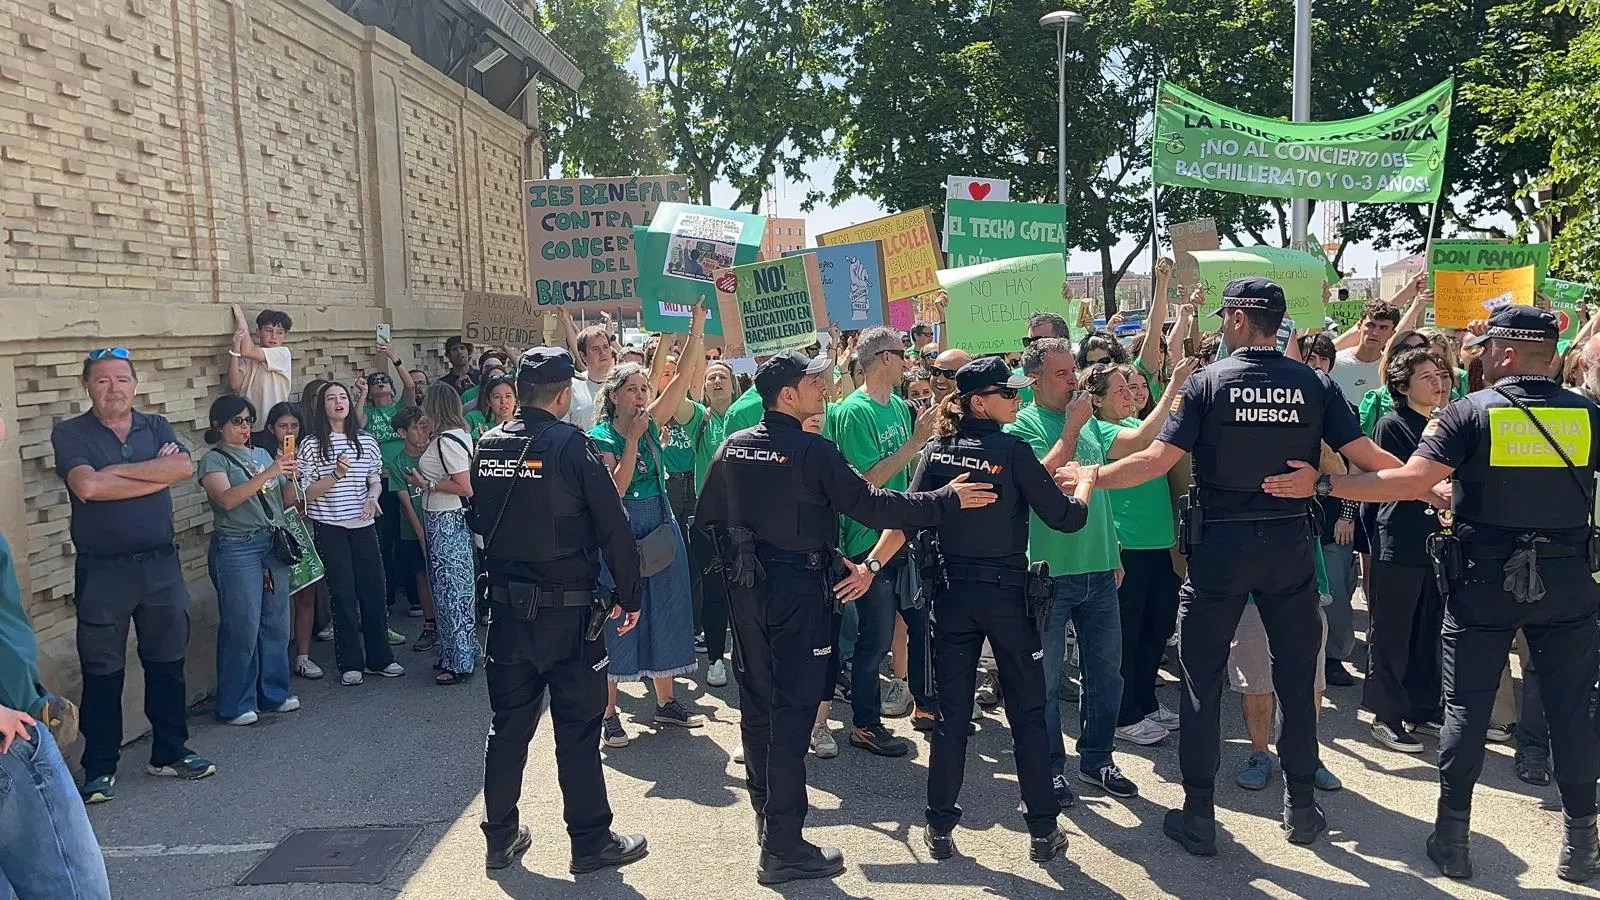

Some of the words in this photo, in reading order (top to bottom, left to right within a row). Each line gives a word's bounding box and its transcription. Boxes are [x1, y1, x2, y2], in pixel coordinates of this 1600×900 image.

[1184, 114, 1213, 129] LA
[1200, 140, 1239, 159] ¡NO
[1243, 141, 1269, 158] AL
[1274, 142, 1379, 168] CONCIERTO
[1381, 152, 1414, 168] DEL
[1175, 160, 1322, 188] BACHILLERATO
[1326, 173, 1338, 189] Y
[1376, 170, 1432, 193] AÑOS!
[579, 177, 681, 207] BINÉFAR
[541, 210, 634, 232] CONTRA
[949, 216, 966, 236] EL
[969, 217, 1016, 240] TECHO
[1020, 221, 1066, 244] GOTEA
[591, 257, 631, 274] DEL
[1433, 249, 1472, 266] DON
[752, 264, 788, 296] NO!
[888, 267, 935, 294] PELEA
[1265, 262, 1309, 281] educando
[970, 280, 992, 298] NO
[1005, 276, 1036, 296] HAY
[743, 299, 755, 315] AL
[755, 290, 808, 312] CONCIERTO
[970, 300, 1031, 323] PUEBLO
[744, 307, 796, 329] EDUCATIVO
[797, 305, 811, 320] EN
[483, 326, 537, 345] DEFIENDE
[745, 320, 813, 344] BACHILLERATO
[1229, 387, 1305, 406] POLICIA
[1235, 407, 1300, 424] HUESCA
[1499, 420, 1582, 437] POLCIA
[725, 448, 779, 461] POLICIA
[1505, 442, 1578, 457] HUESA
[479, 459, 529, 469] POLICA
[930, 452, 990, 470] POLICIA
